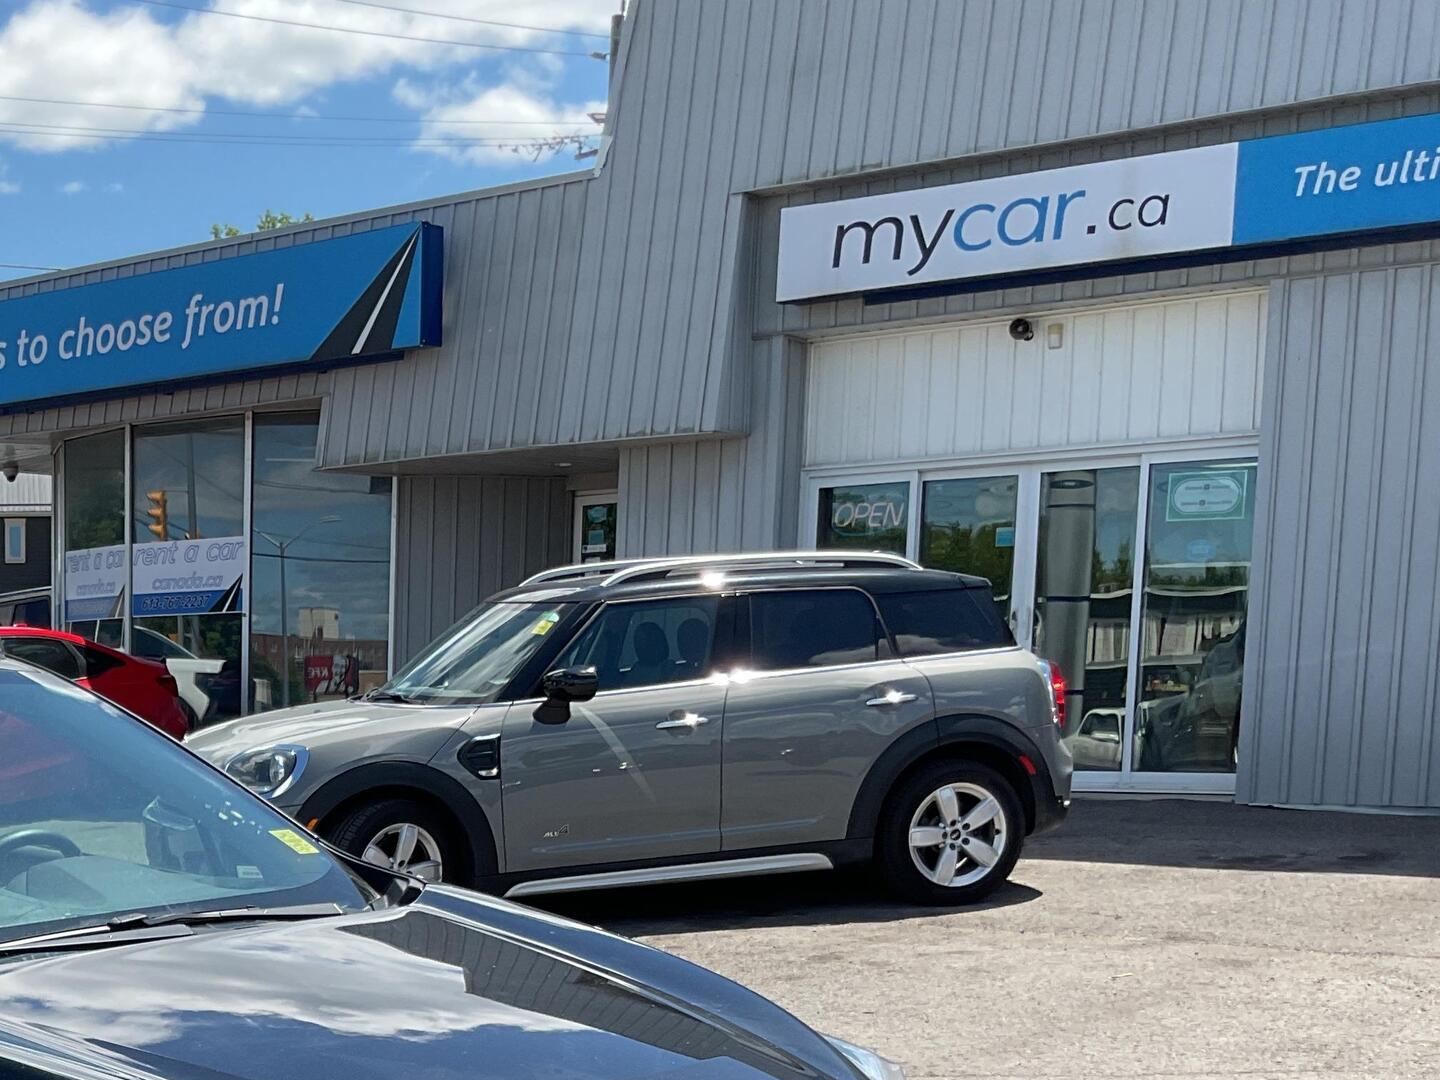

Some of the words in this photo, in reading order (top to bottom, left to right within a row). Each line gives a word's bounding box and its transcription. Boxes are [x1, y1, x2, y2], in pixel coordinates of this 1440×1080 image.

[1295, 161, 1361, 197] The
[832, 189, 1170, 276] mycar.ca
[17, 329, 48, 367] to
[58, 316, 173, 360] choose
[181, 283, 284, 349] from!
[834, 501, 905, 528] OPEN
[133, 542, 178, 566] rent
[184, 543, 200, 564] a
[206, 541, 244, 562] car
[151, 571, 223, 591] canada.ca
